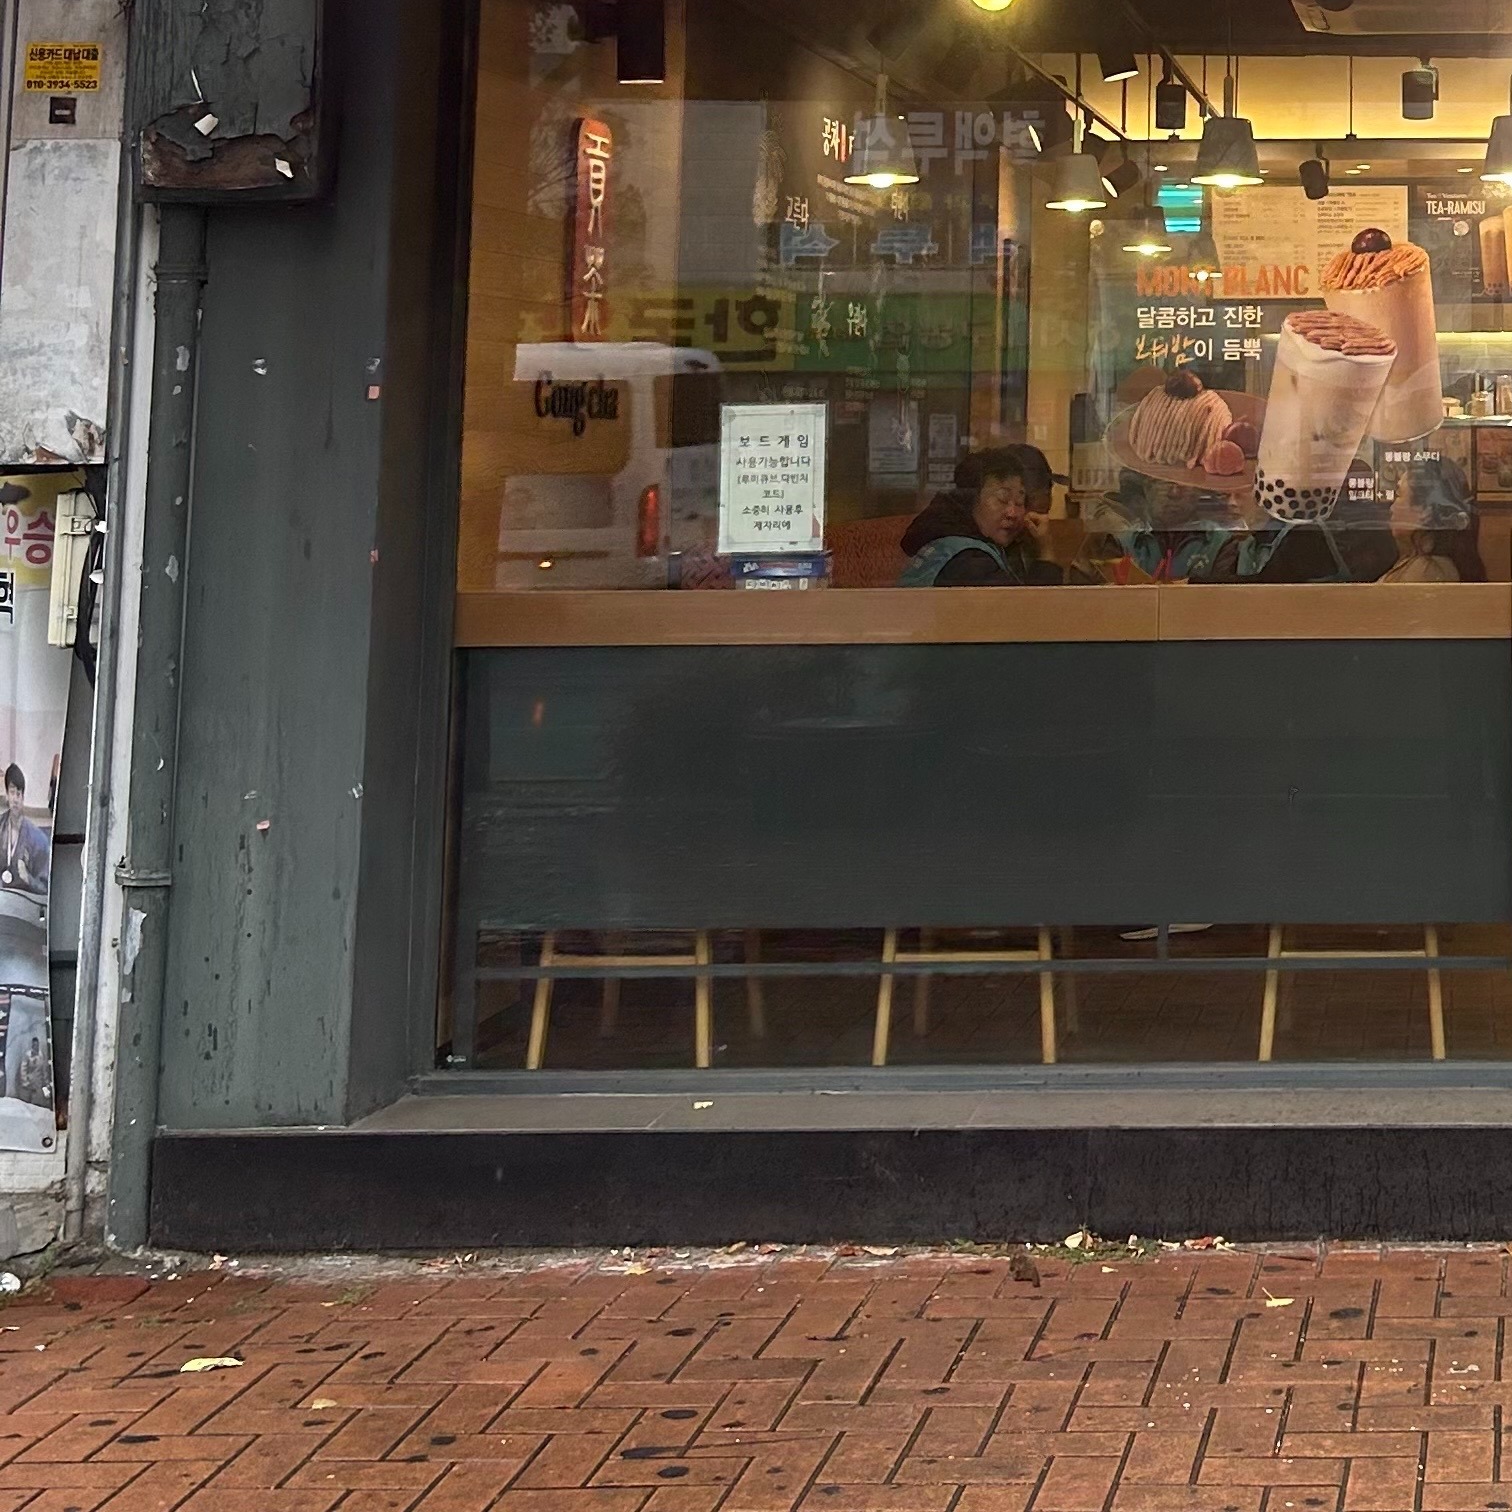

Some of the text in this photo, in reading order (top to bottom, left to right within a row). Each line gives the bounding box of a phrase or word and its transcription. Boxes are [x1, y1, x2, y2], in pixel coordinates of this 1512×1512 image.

[1426, 200, 1487, 215] TEA-RAMISU
[1136, 263, 1311, 298] MONT BLANC
[1136, 305, 1264, 329] 달콤하고 진한
[1221, 337, 1263, 361] 듬뿍
[739, 434, 810, 449] 보드게임
[736, 455, 812, 469] 사용가능합니다
